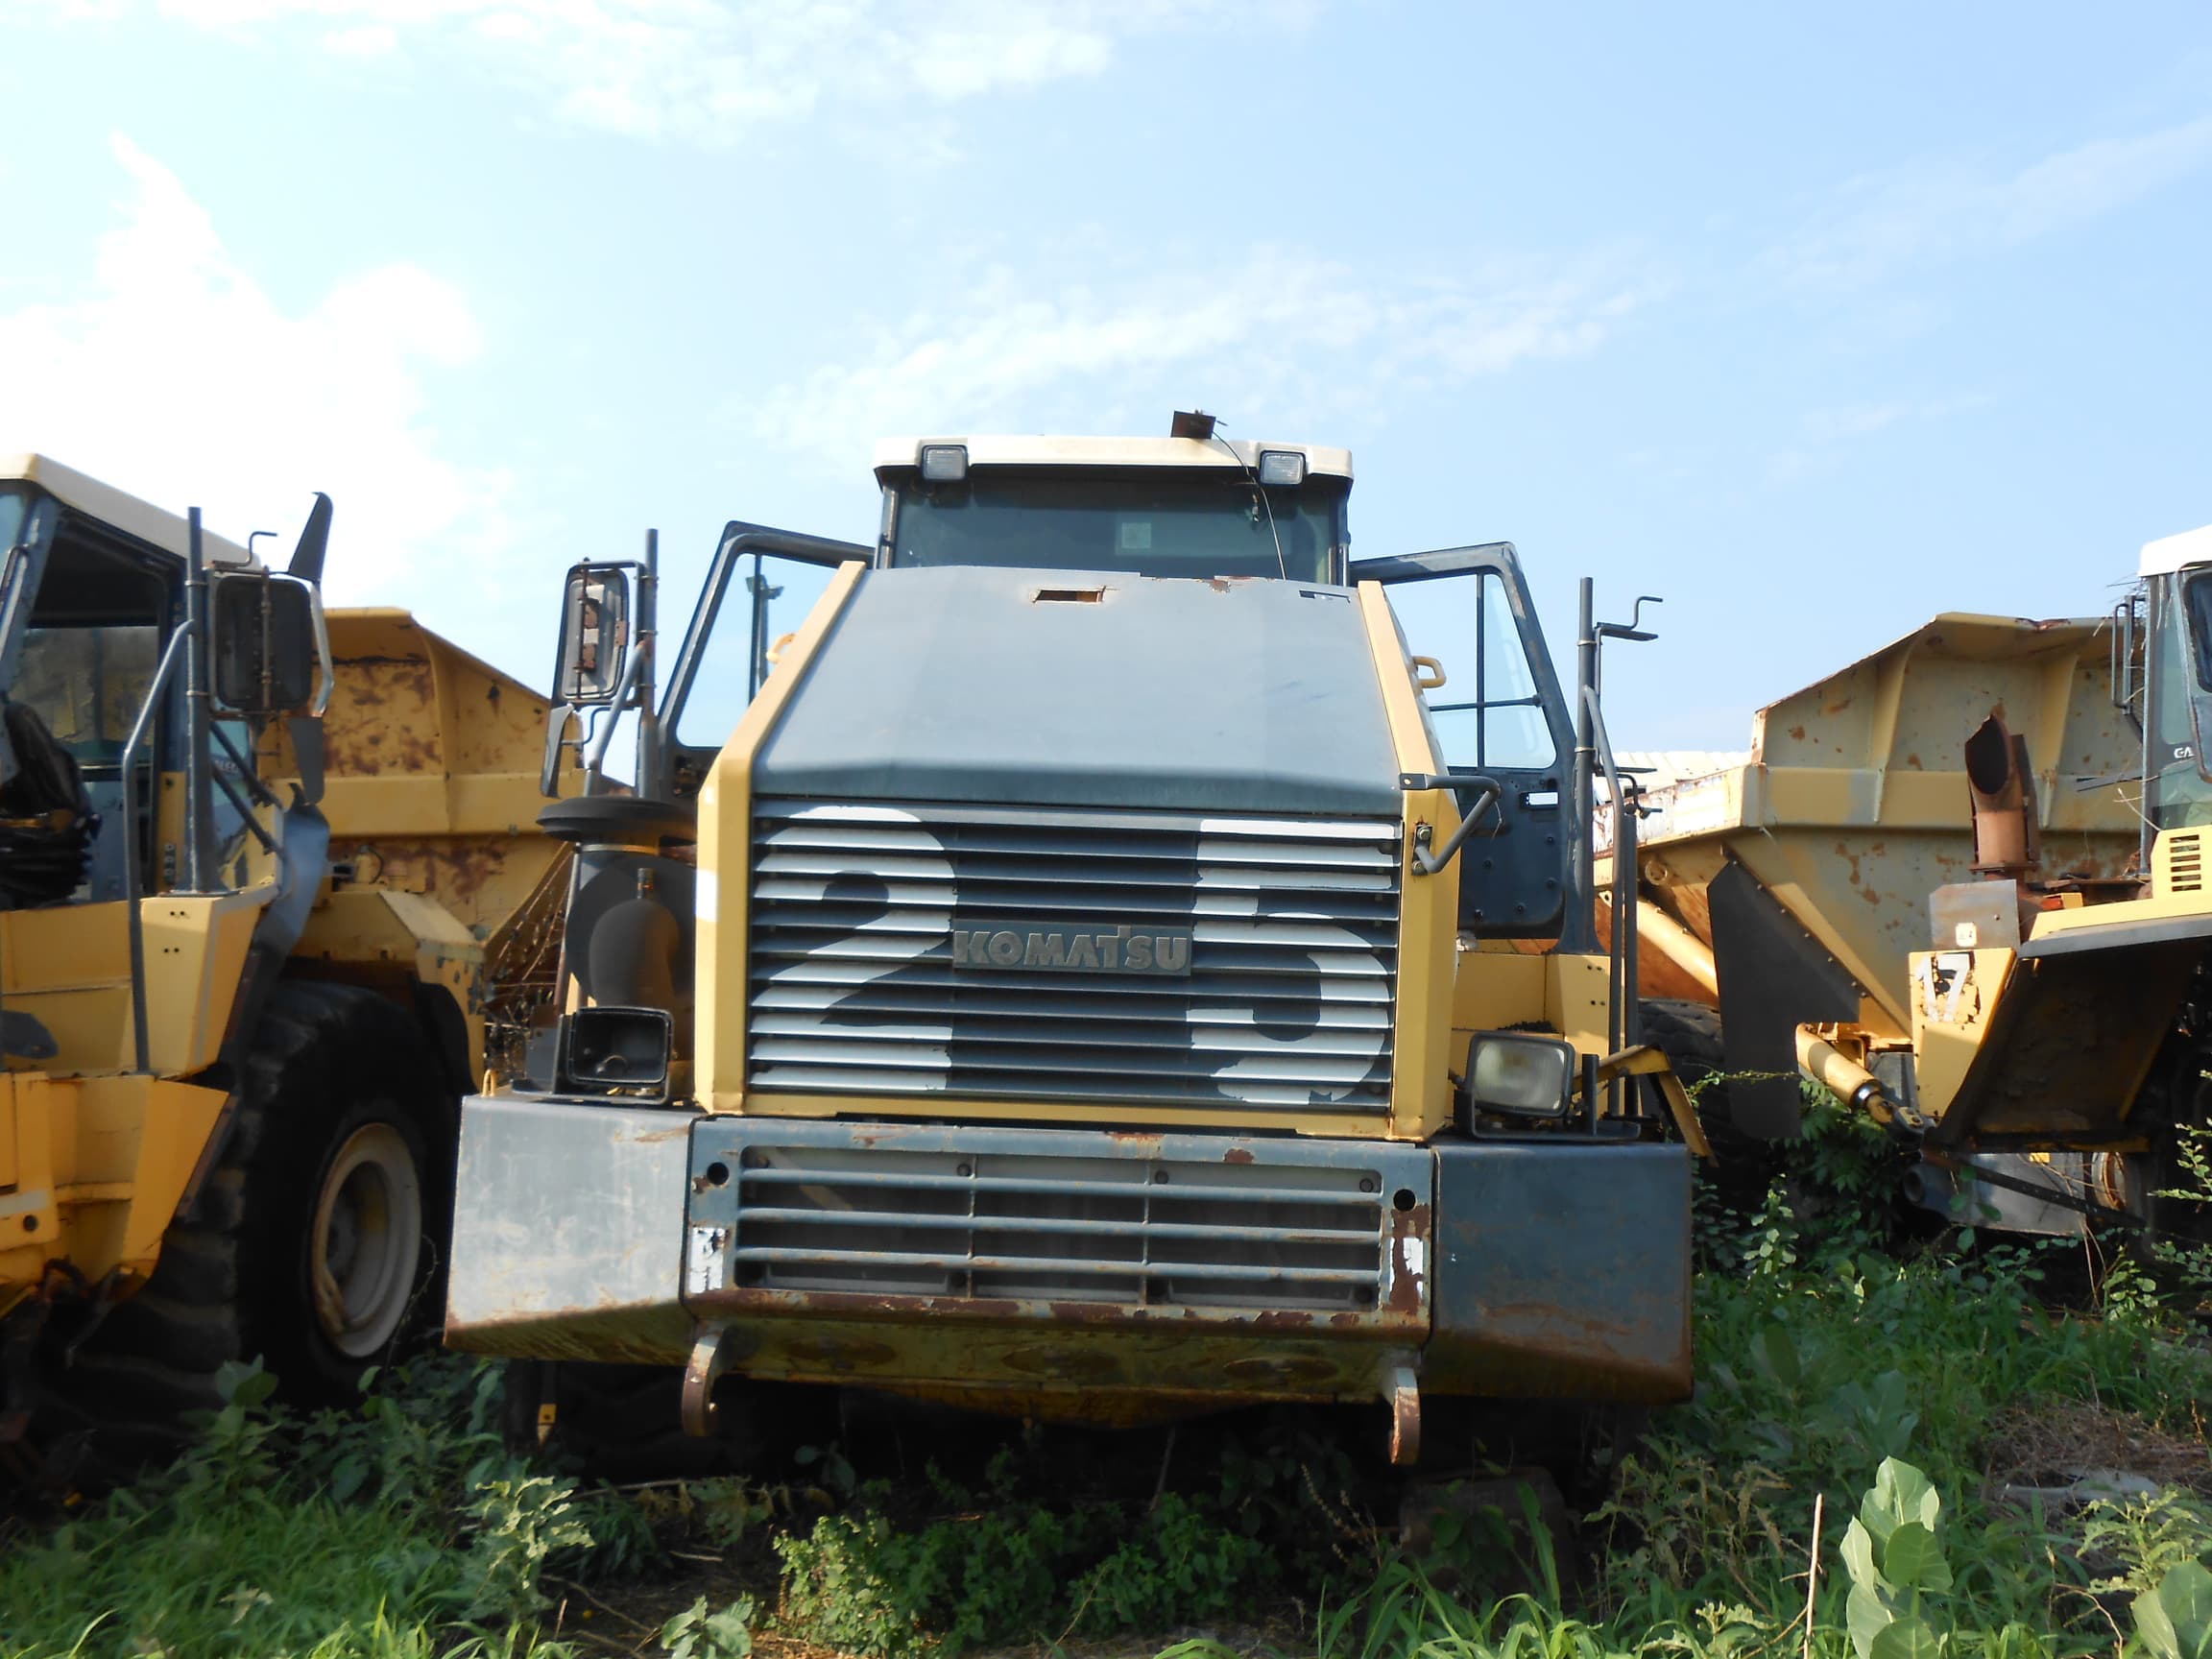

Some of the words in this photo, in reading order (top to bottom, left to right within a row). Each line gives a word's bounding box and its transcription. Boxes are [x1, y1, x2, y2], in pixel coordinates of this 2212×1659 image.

[751, 805, 958, 1091] 2
[953, 925, 1188, 972] KOMATSU
[1186, 819, 1395, 1105] 5
[1916, 952, 1971, 1022] 17
